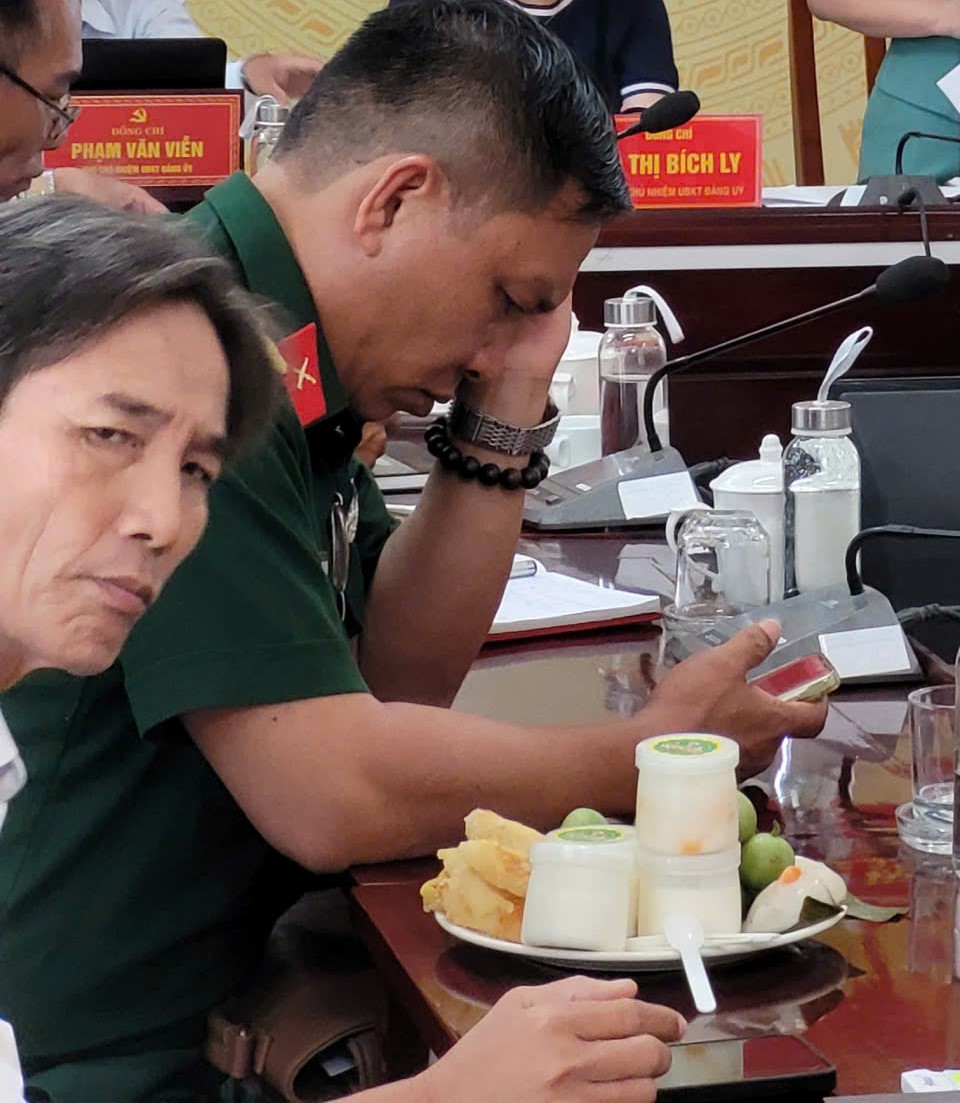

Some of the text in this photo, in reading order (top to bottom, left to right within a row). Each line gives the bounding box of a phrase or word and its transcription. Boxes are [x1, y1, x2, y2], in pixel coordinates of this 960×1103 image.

[71, 142, 121, 162] PHẠM
[126, 138, 160, 158] VĂN
[629, 149, 742, 179] THỊ BÍCH LY
